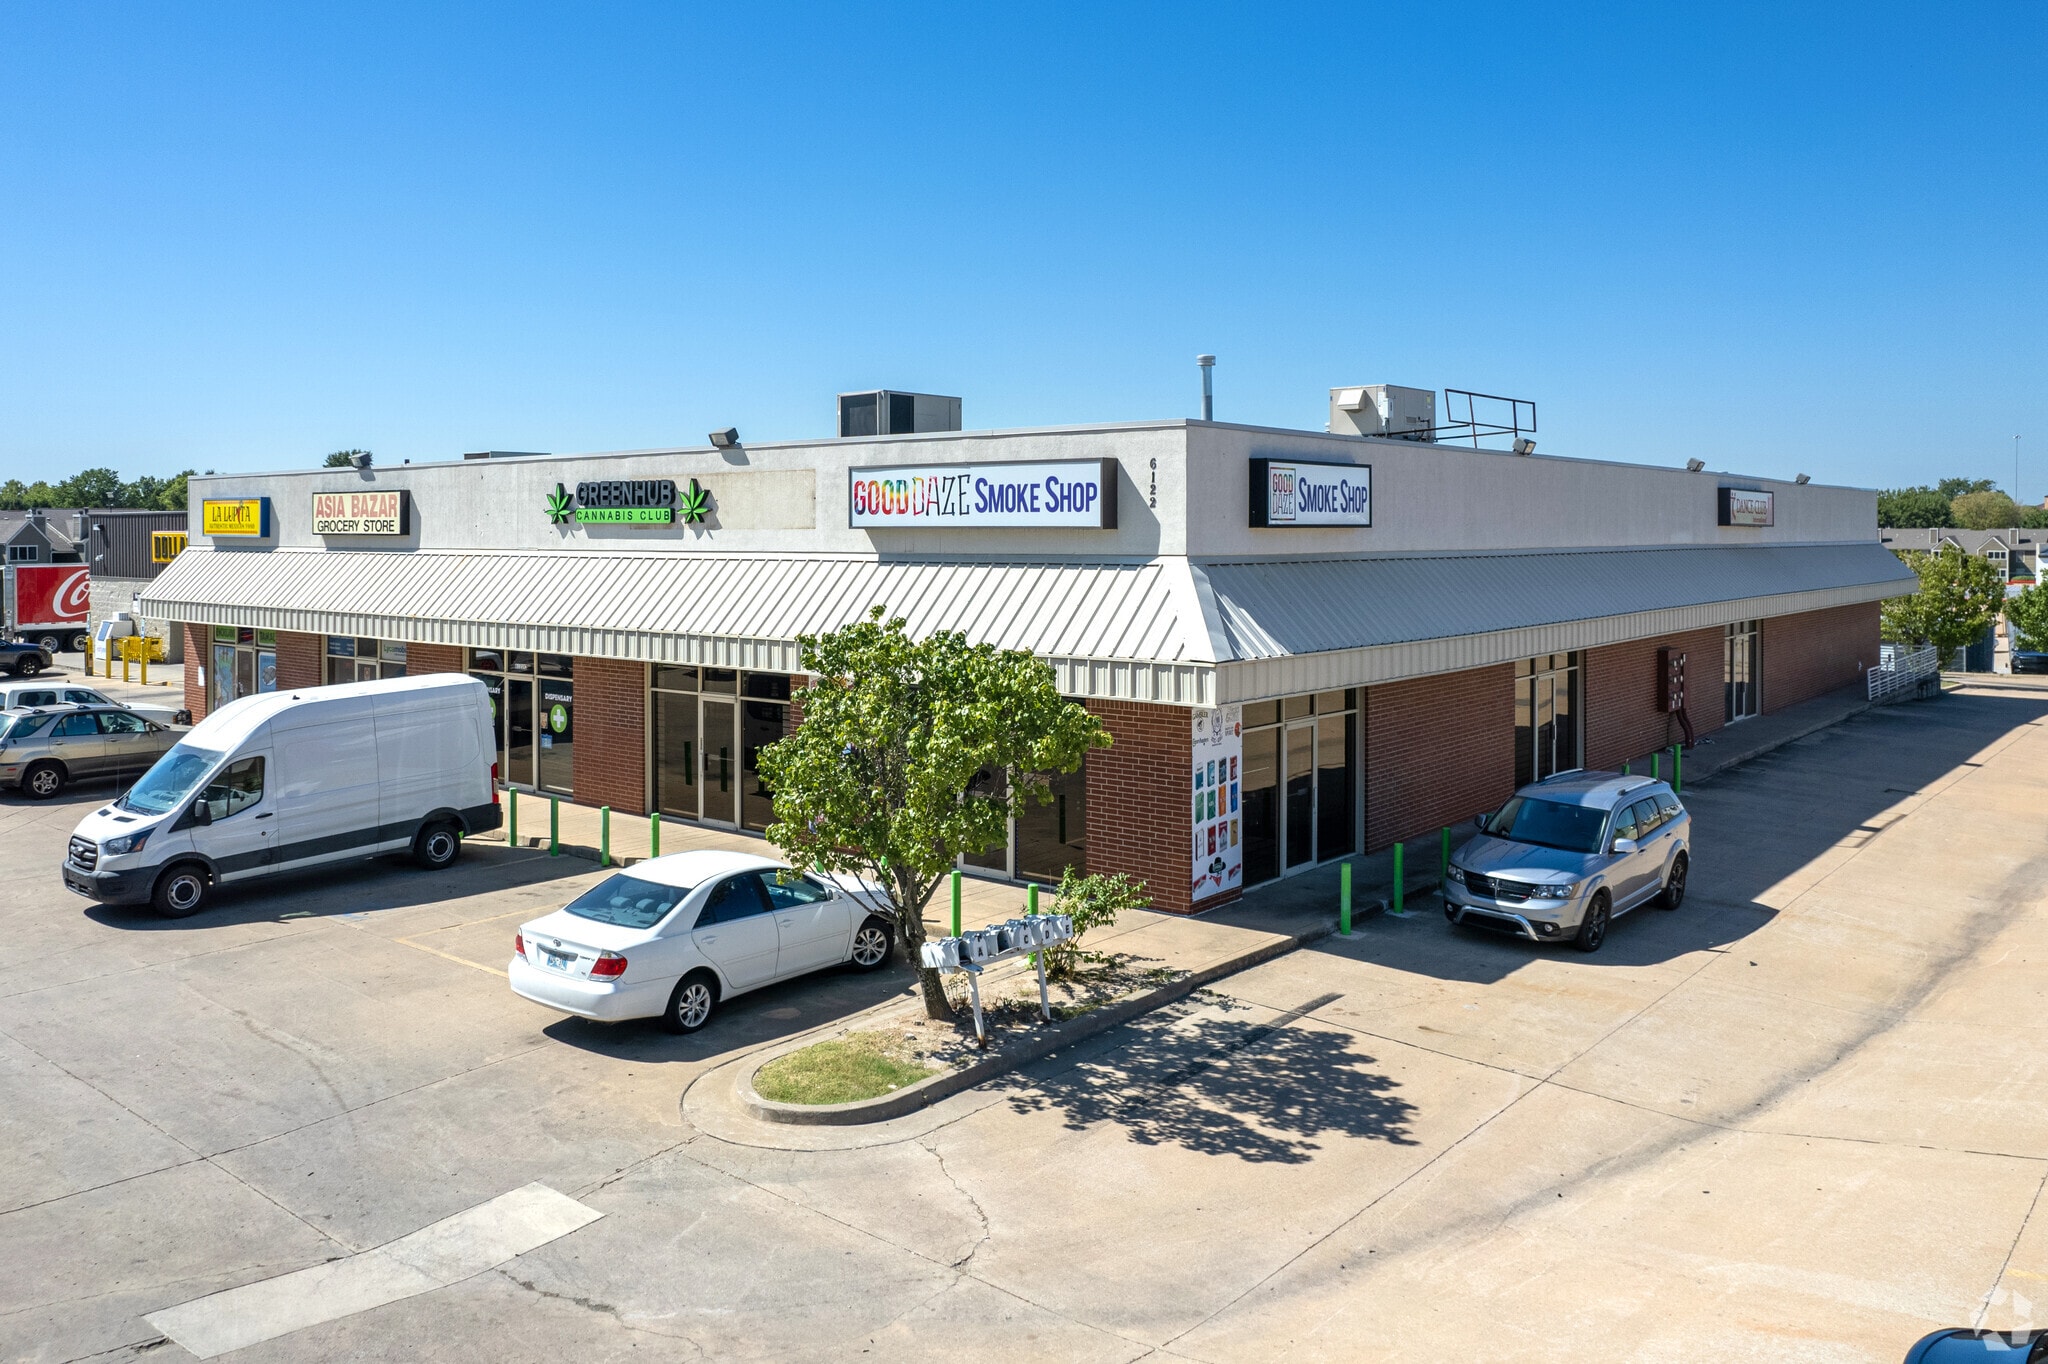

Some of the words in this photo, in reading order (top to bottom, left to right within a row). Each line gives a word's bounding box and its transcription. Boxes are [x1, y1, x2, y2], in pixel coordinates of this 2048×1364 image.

[576, 479, 675, 507] GREENHUB
[1272, 473, 1293, 493] GOOD
[853, 479, 909, 516] GOOD
[911, 474, 971, 517] DAZE
[974, 477, 1041, 514] SMOKE
[1045, 475, 1098, 513] SHOP
[1272, 493, 1294, 515] DAZE
[1298, 477, 1338, 513] SMOKE
[1340, 479, 1368, 513] SHOP
[212, 506, 222, 522] LA
[315, 495, 346, 519] ASIA
[351, 494, 398, 518] BAZAR
[576, 511, 633, 522] CANNABIS
[639, 510, 671, 521] CLUB
[317, 520, 360, 532] GROCERY
[363, 520, 395, 532] STORE
[544, 693, 573, 702] DISPENSARY
[1065, 924, 1070, 934] E
